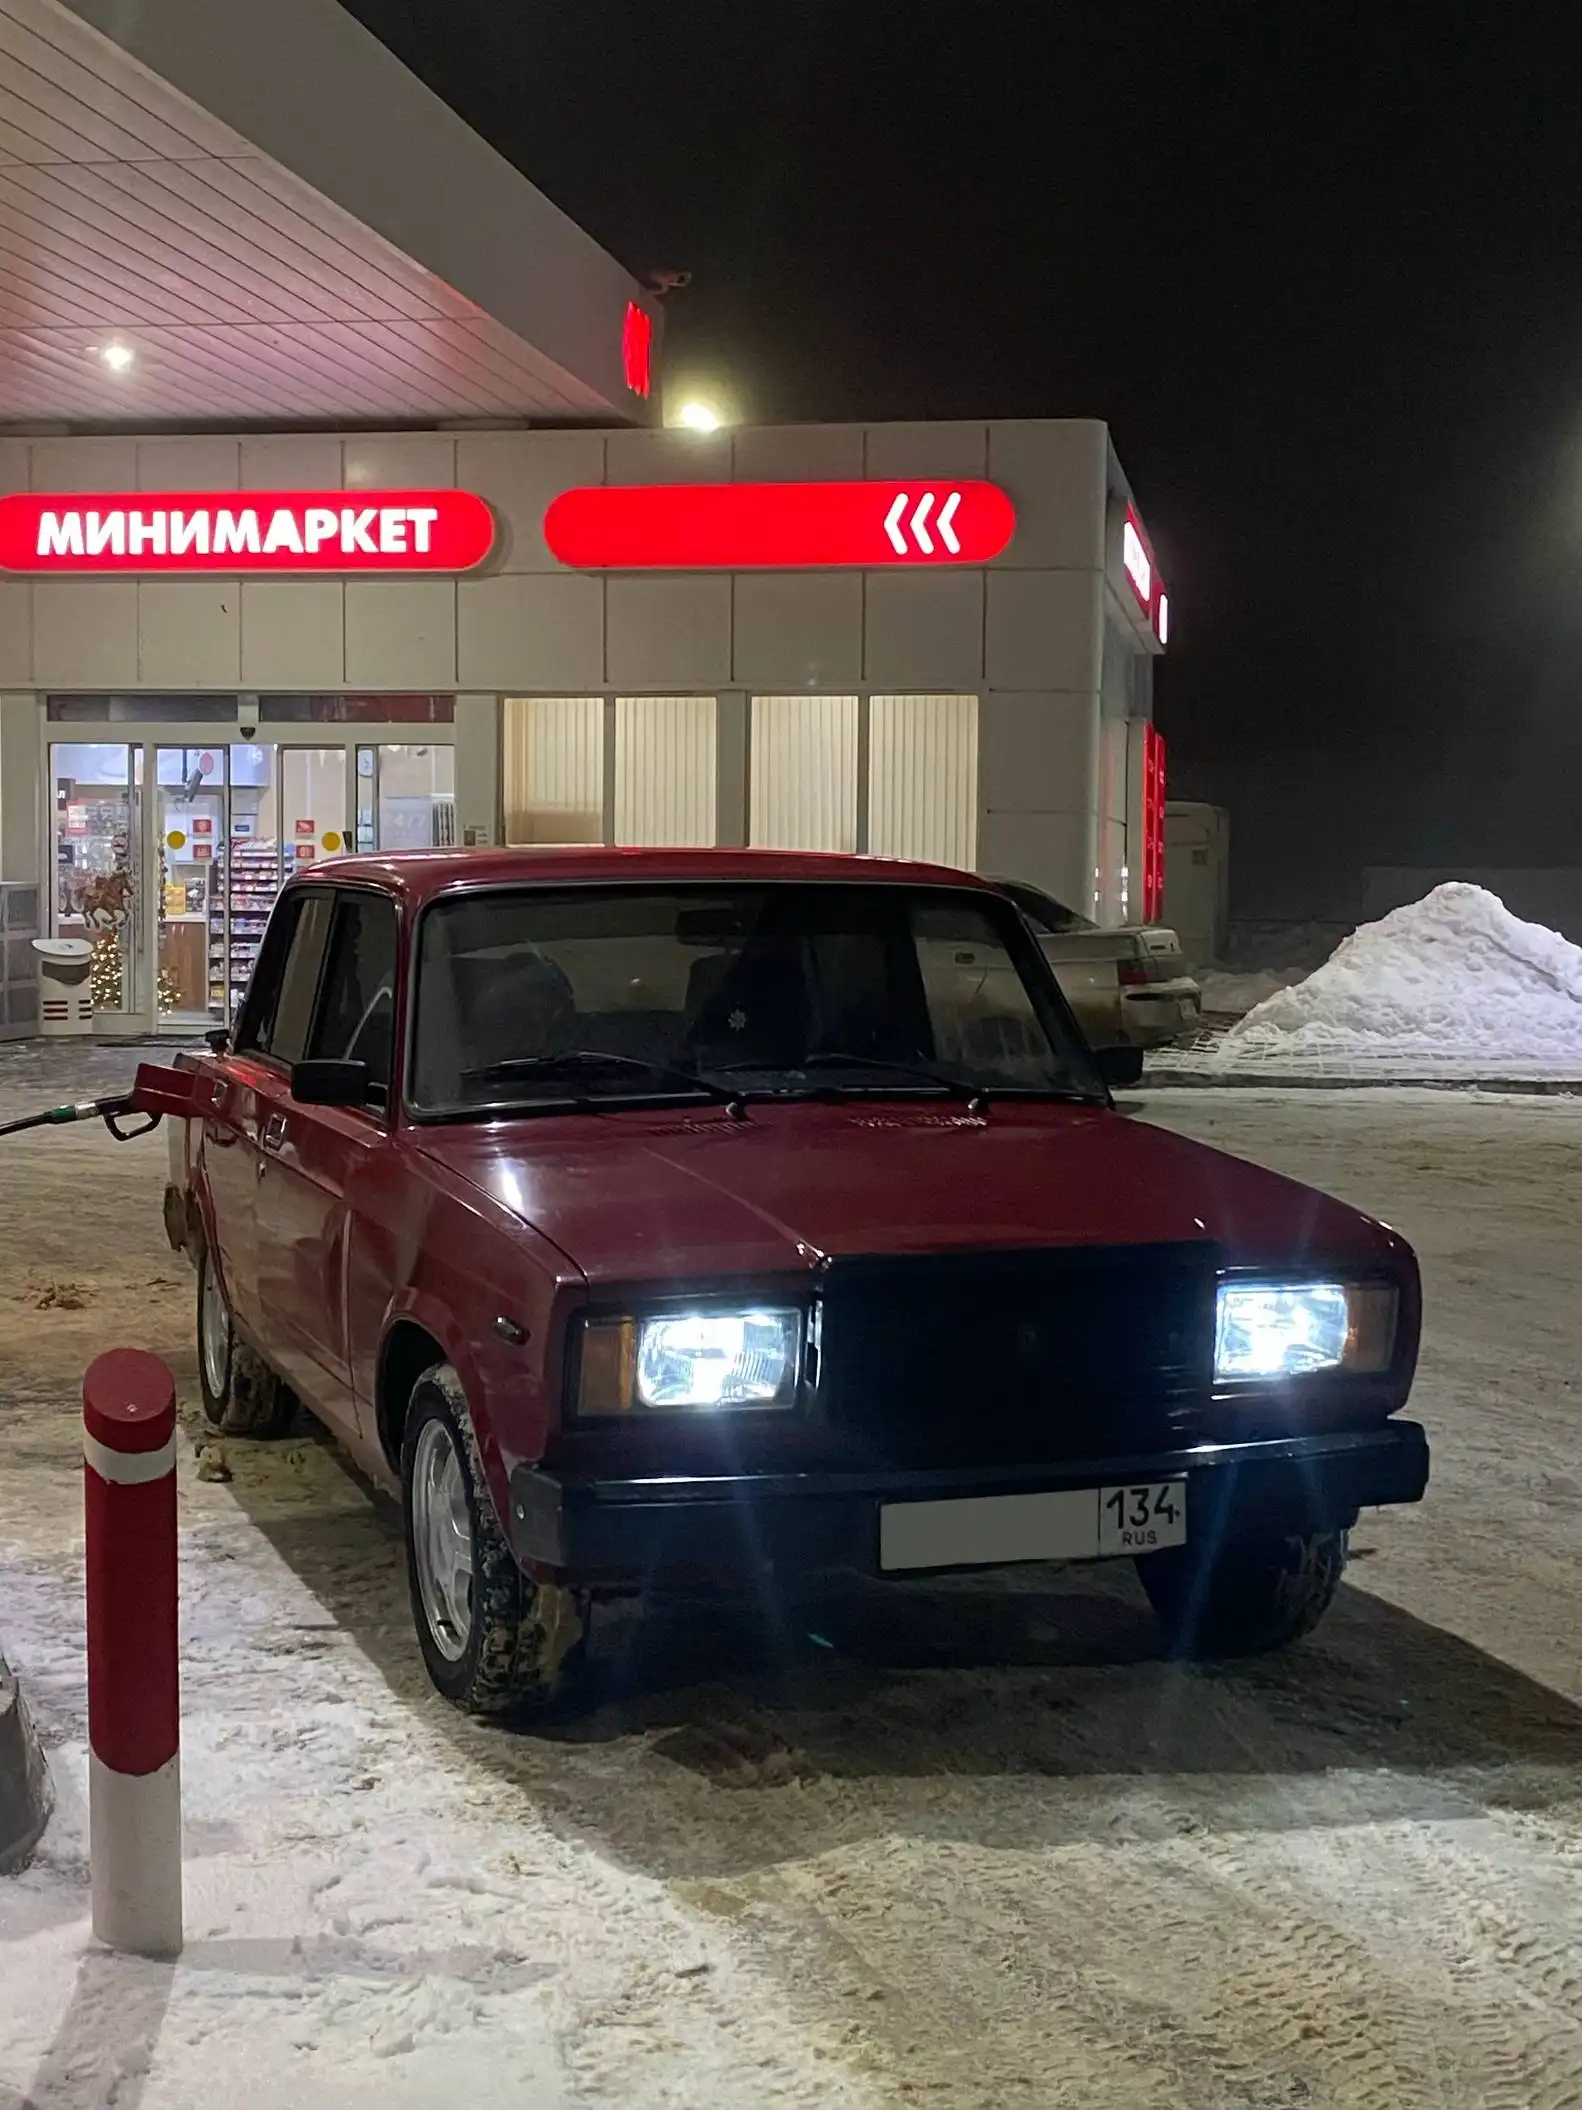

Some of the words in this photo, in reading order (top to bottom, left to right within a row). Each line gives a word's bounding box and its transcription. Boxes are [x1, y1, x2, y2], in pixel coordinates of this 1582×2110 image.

[36, 508, 438, 555] МИНИМАРКЕТ
[1106, 1485, 1174, 1529] 134
[1122, 1530, 1157, 1546] RUS
